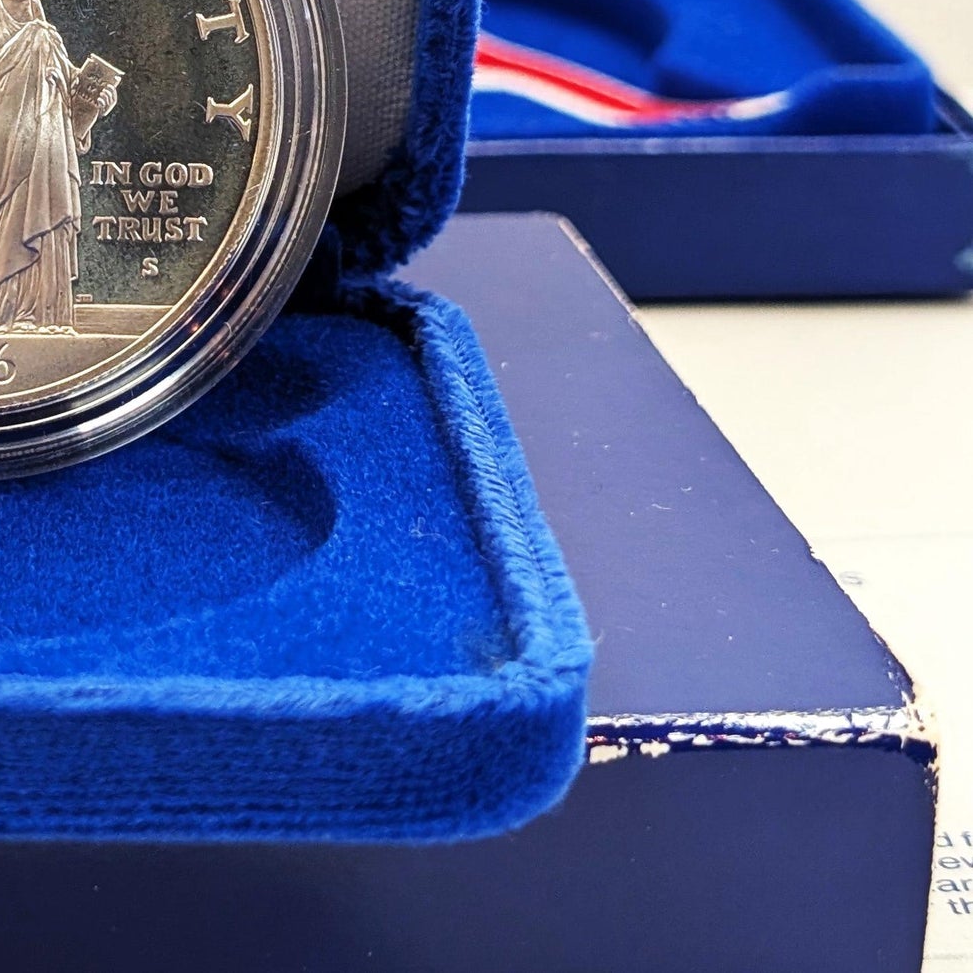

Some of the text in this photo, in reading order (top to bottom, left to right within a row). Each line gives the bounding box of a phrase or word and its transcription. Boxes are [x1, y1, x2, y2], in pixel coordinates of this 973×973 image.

[89, 161, 214, 188] IN GOD
[120, 189, 178, 215] WE
[92, 215, 208, 243] TRUST
[141, 257, 159, 278] S
